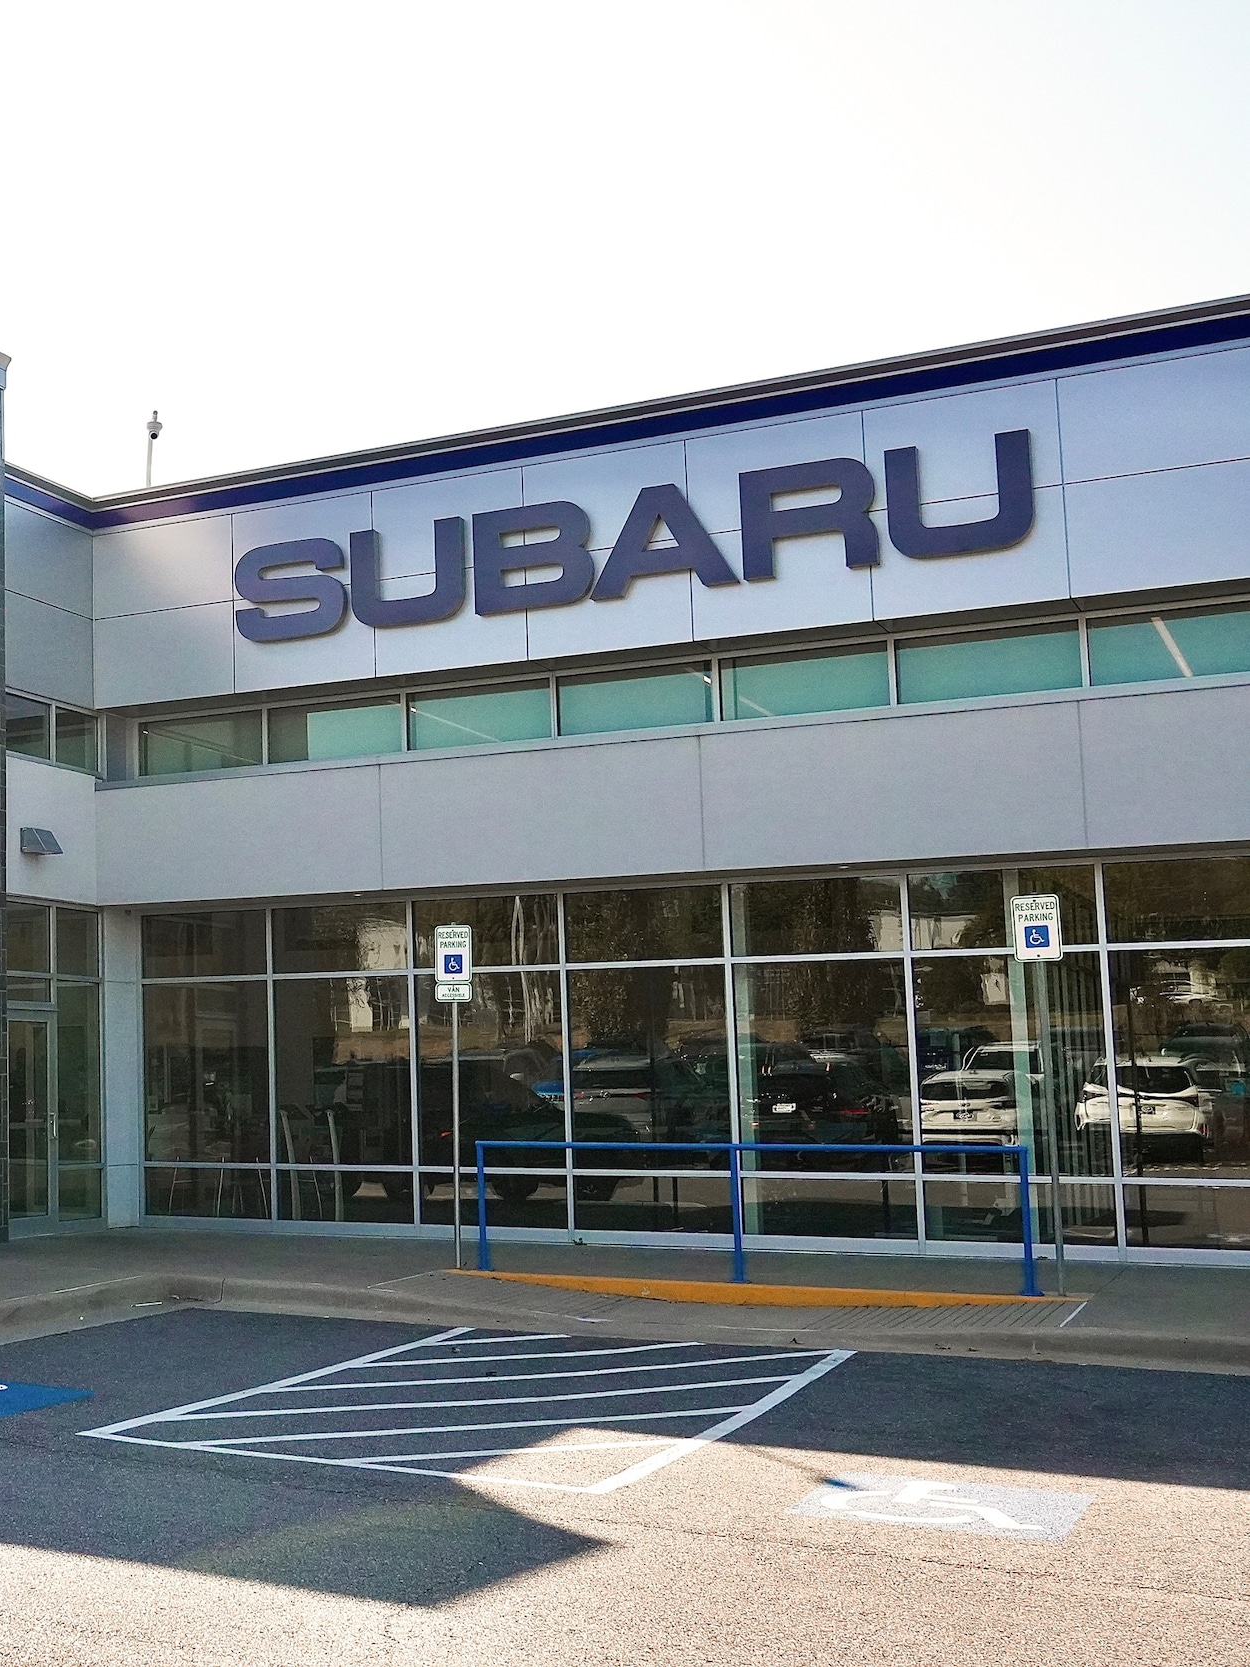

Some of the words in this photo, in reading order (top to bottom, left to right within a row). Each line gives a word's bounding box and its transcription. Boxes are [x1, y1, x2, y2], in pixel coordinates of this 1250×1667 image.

[235, 429, 1036, 642] SUBARU
[1014, 901, 1056, 911] RESERVED
[1018, 912, 1054, 922] PARKING
[437, 930, 469, 939] RESERVED
[439, 940, 467, 949] PARKING
